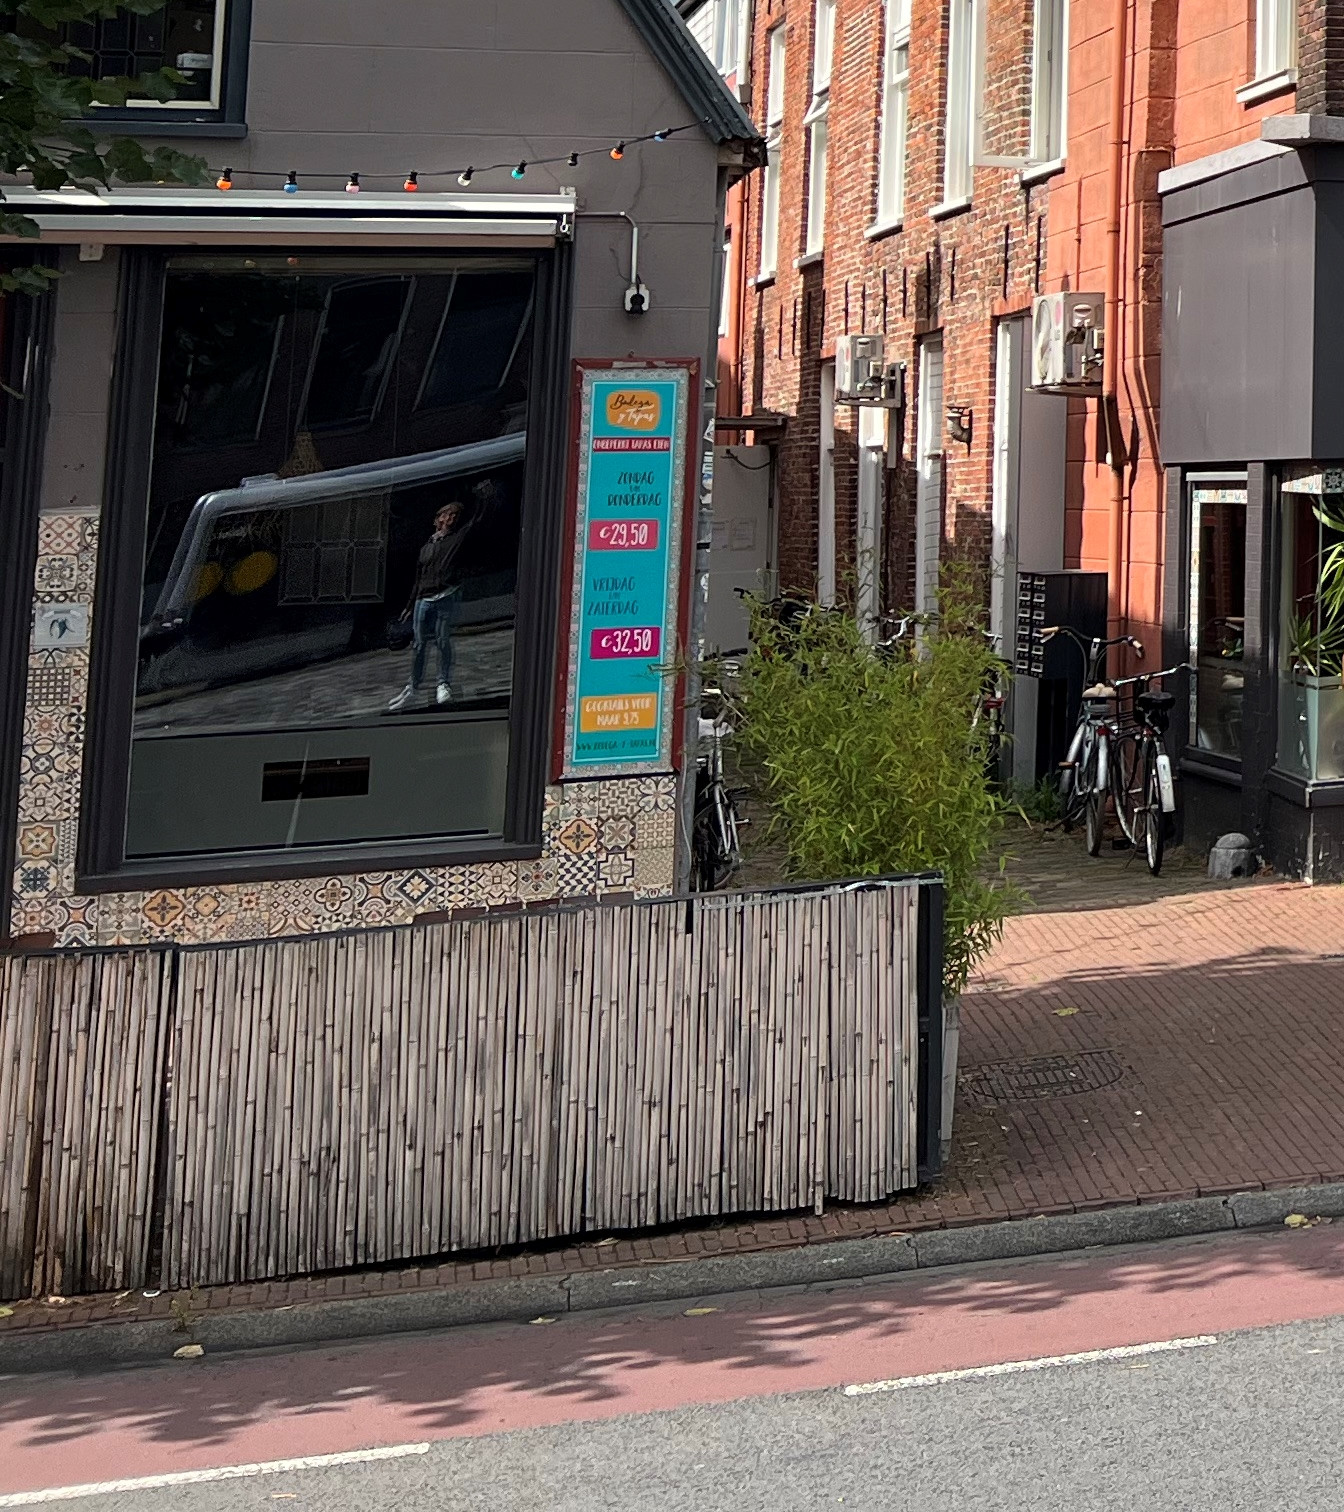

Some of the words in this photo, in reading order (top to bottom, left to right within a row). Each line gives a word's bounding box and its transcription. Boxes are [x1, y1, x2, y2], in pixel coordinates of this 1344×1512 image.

[610, 394, 655, 410] Bodega
[625, 404, 655, 425] Tapas
[617, 471, 655, 485] ZONDAG
[607, 492, 662, 506] DONDERDAG
[592, 576, 636, 592] VRIJDAG
[587, 600, 640, 616] ZATERDAG
